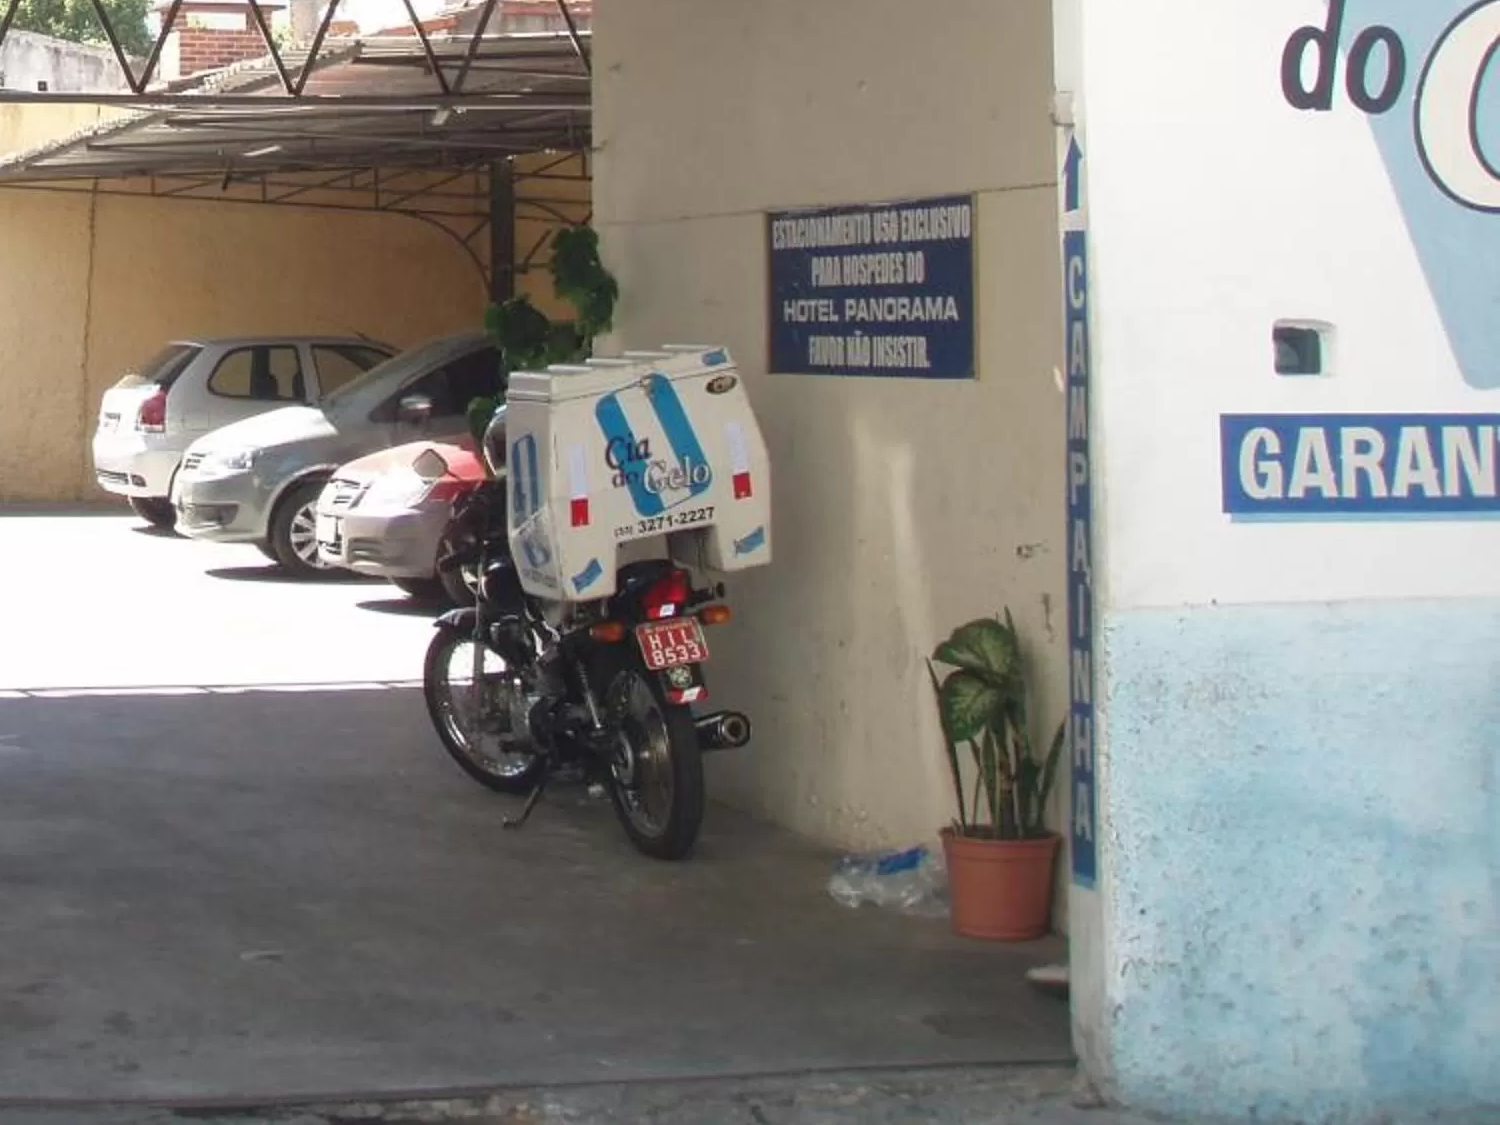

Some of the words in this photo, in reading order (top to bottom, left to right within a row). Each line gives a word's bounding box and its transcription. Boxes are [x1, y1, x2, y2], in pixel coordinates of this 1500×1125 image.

[772, 213, 871, 249] ESTACIONAMENTO
[873, 210, 899, 243] USO
[900, 204, 971, 241] EXCLUSIVO
[811, 255, 842, 287] PARA
[843, 252, 904, 286] HOSPEDES
[905, 250, 925, 284] DO
[783, 298, 839, 322] HOTEL
[845, 295, 959, 322] PANORAMA
[808, 335, 845, 367] FAVOR
[846, 330, 871, 367] NÃO
[605, 431, 652, 470] Cia
[1238, 425, 1500, 500] GARAN
[612, 466, 639, 488] do
[644, 455, 712, 494] Gelo
[1068, 255, 1094, 842] CAMPAINHA
